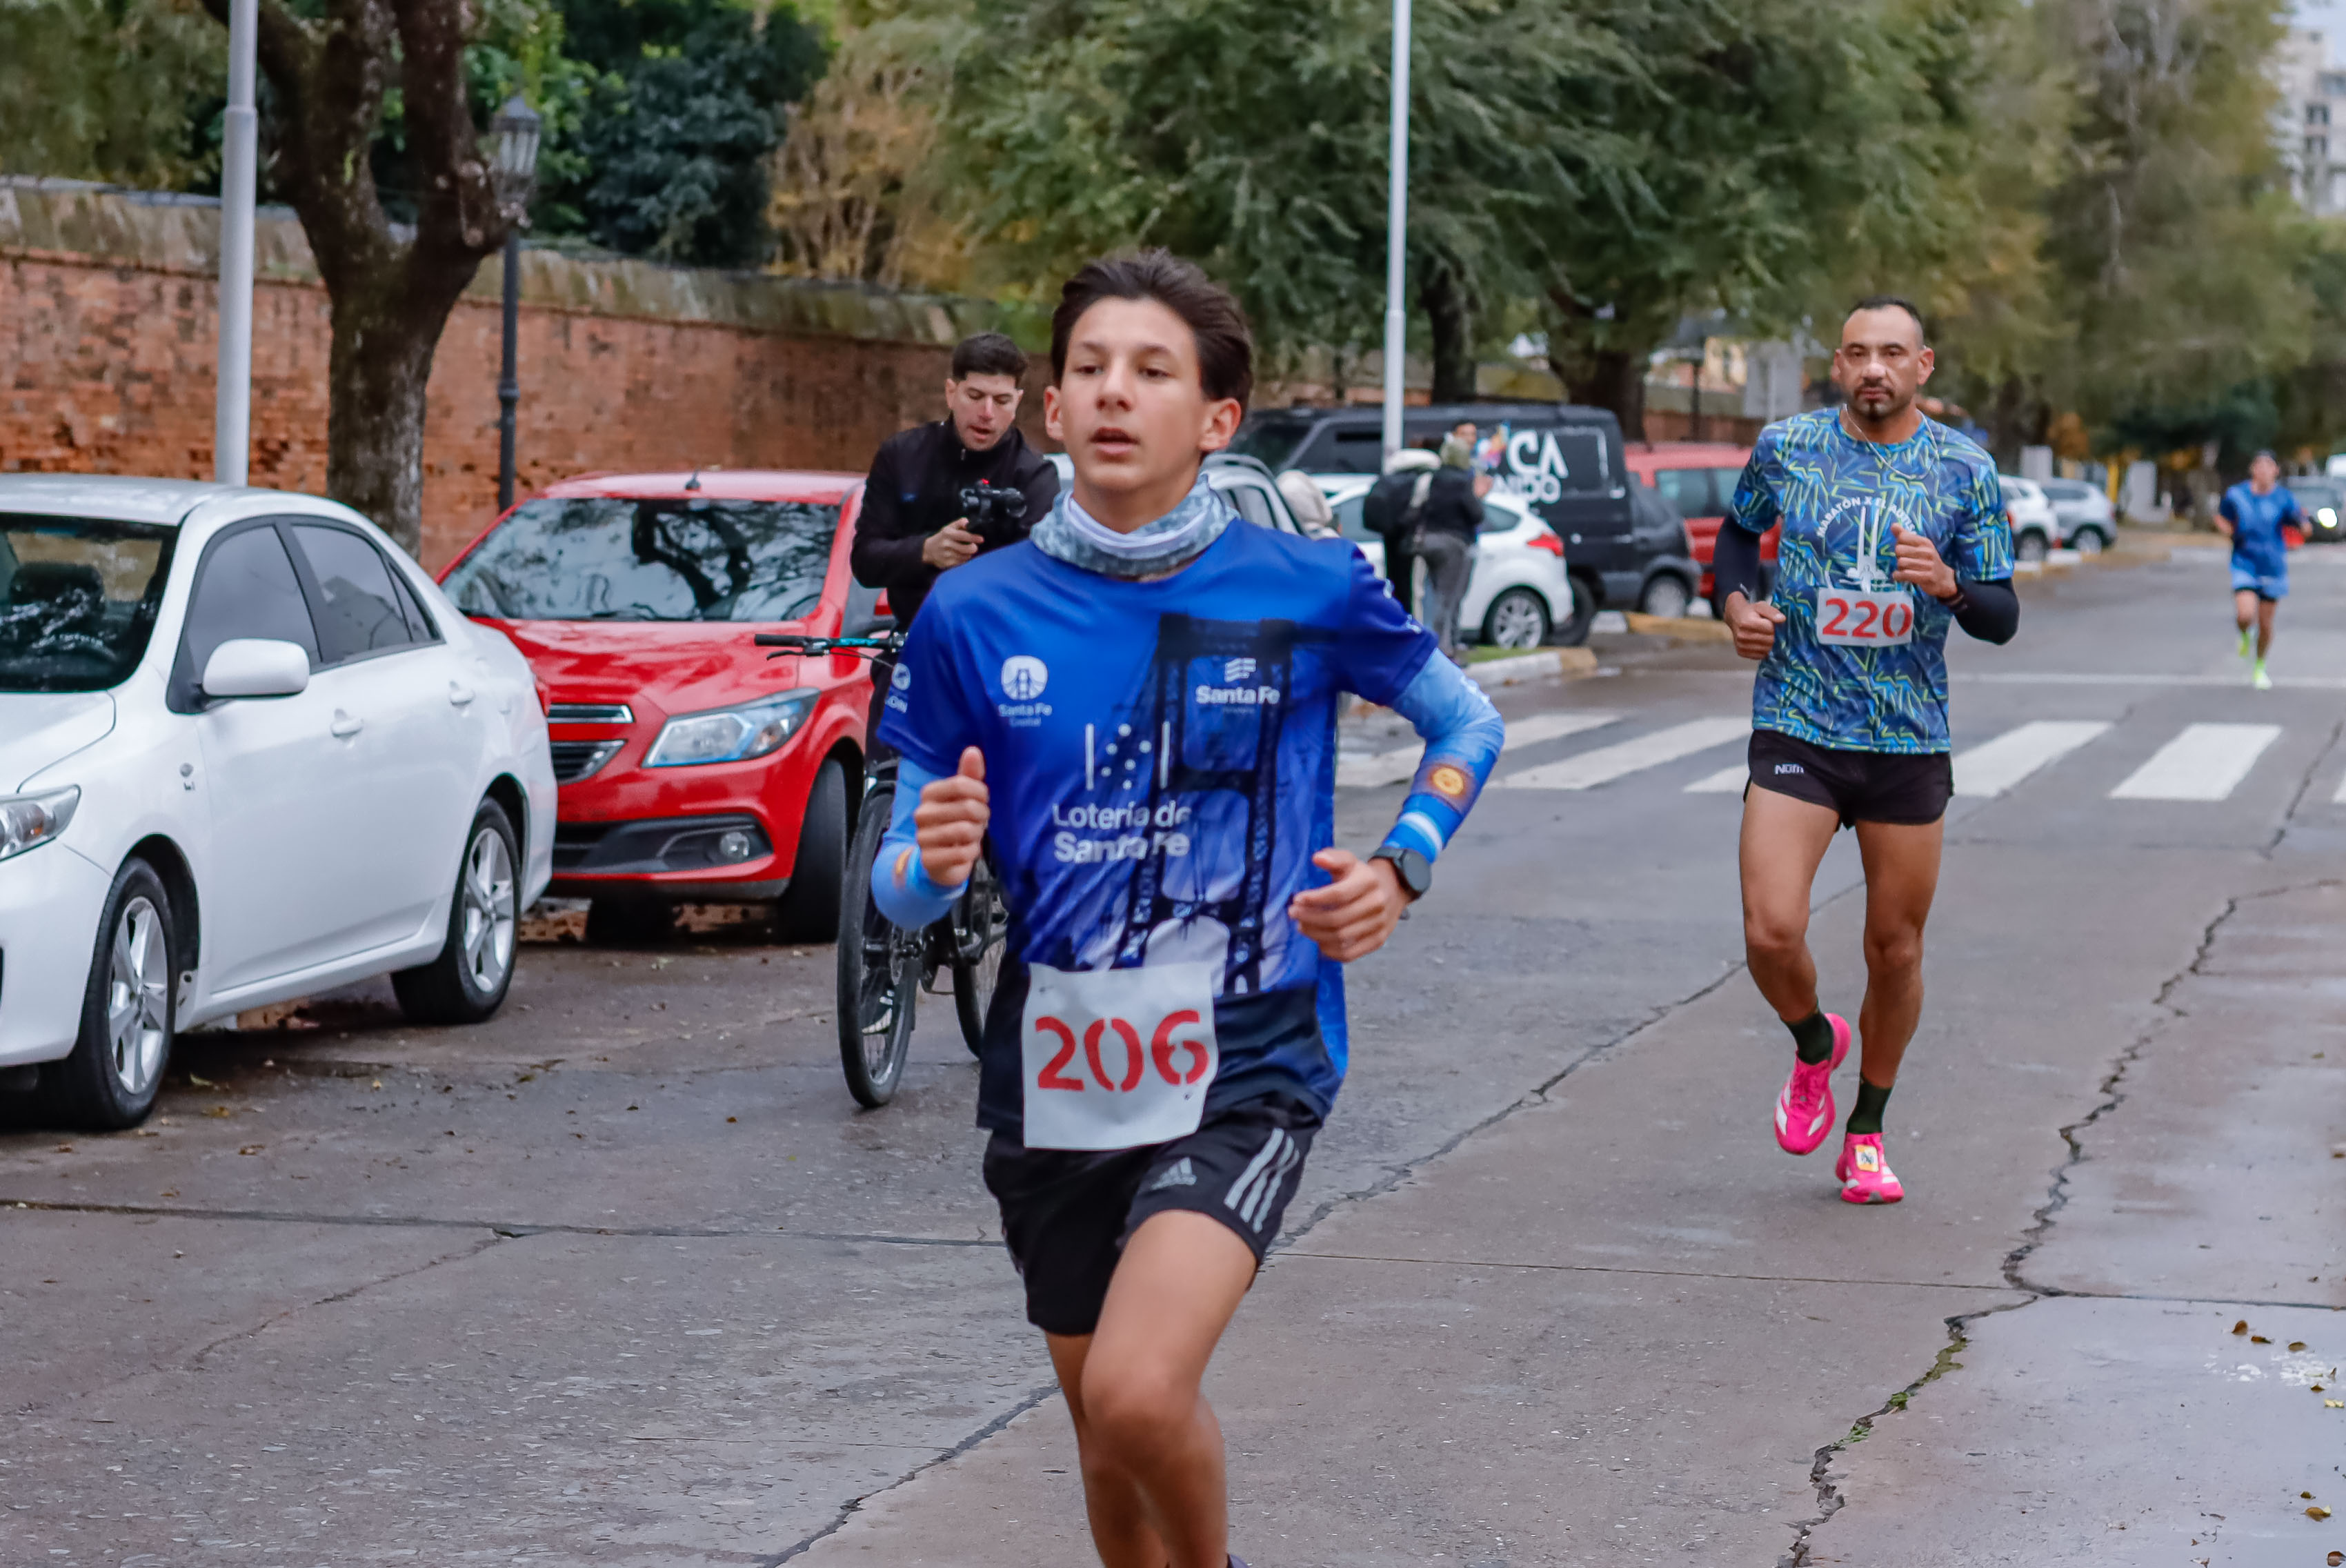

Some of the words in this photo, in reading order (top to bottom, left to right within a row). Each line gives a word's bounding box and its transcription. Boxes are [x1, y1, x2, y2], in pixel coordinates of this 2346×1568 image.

[1864, 496, 1873, 506] X
[1822, 597, 1913, 639] 220
[1195, 685, 1257, 704] Santa
[1258, 685, 1280, 704] Fe
[1053, 831, 1149, 864] Santa
[1035, 1009, 1209, 1093] 206
